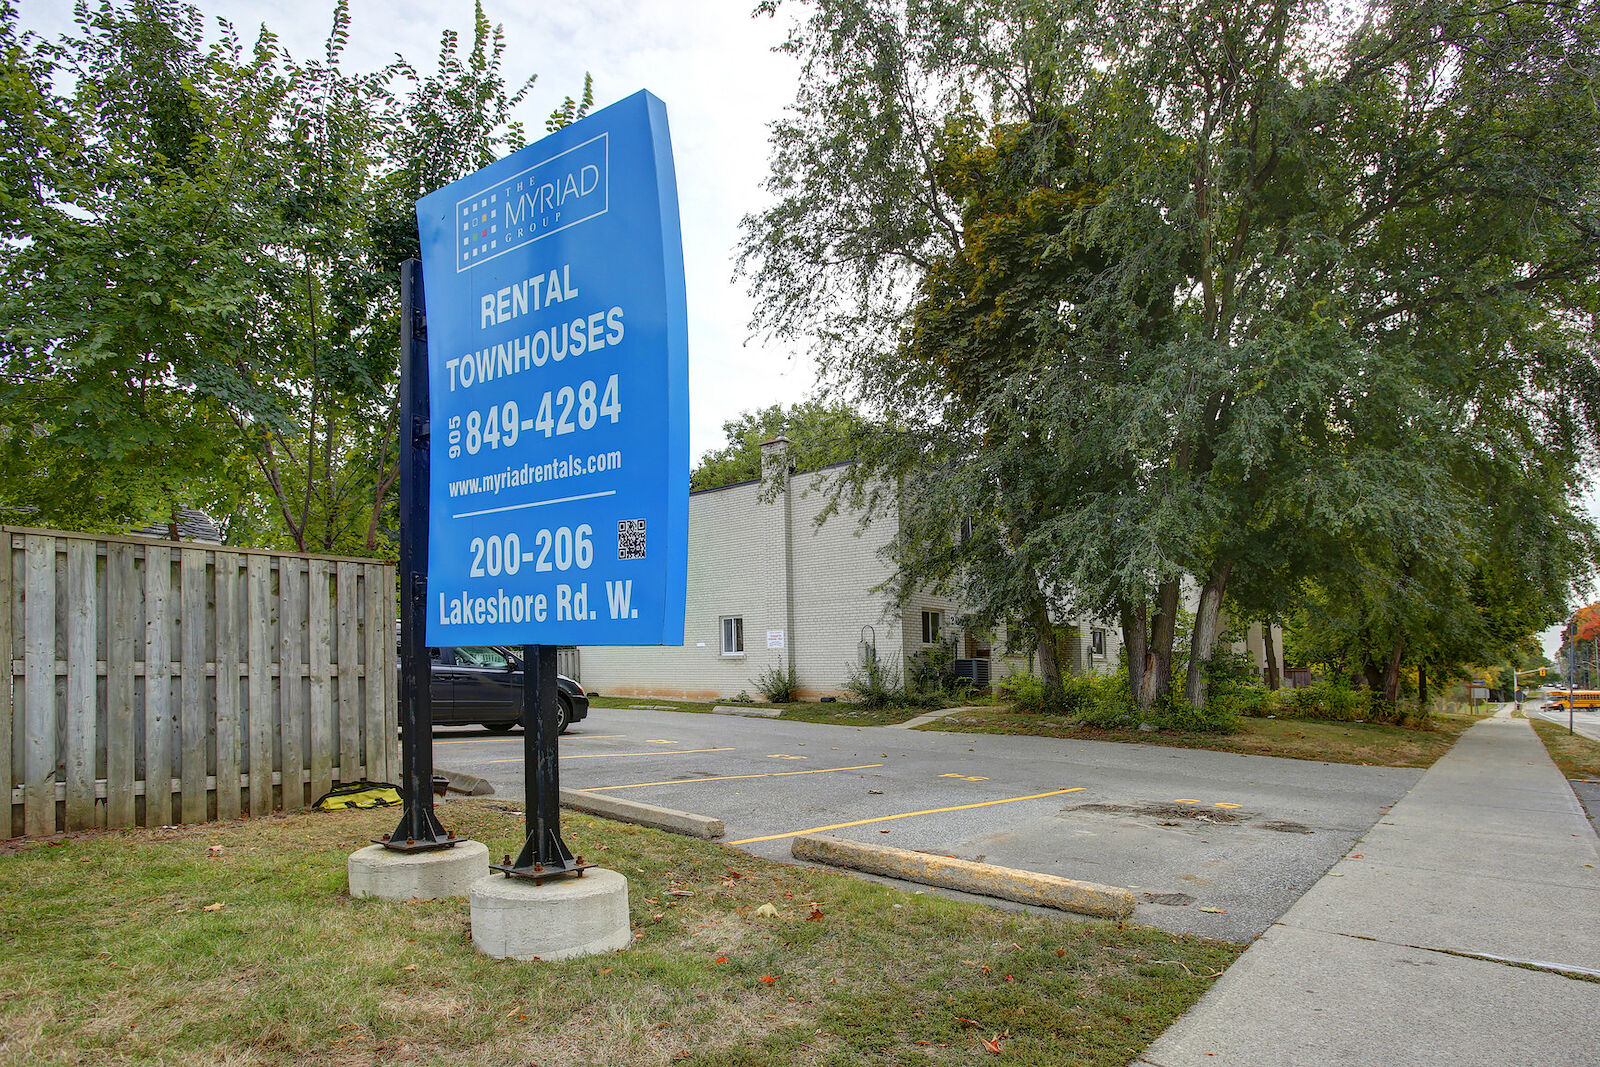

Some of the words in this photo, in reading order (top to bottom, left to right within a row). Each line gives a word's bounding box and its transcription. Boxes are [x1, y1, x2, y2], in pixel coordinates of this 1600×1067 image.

[505, 176, 535, 197] THE
[505, 164, 599, 229] MYRIAD
[505, 212, 561, 242] GROUP
[481, 264, 579, 329] RENTAL
[446, 306, 625, 392] TOWNHOUSES
[448, 415, 461, 459] 905
[466, 373, 622, 455] 849-4284
[449, 450, 621, 497] www.myriadrentals.com
[469, 523, 594, 578] 200-206
[439, 588, 547, 625] Lakeshore
[556, 583, 597, 621] Rd.
[605, 580, 638, 619] W.
